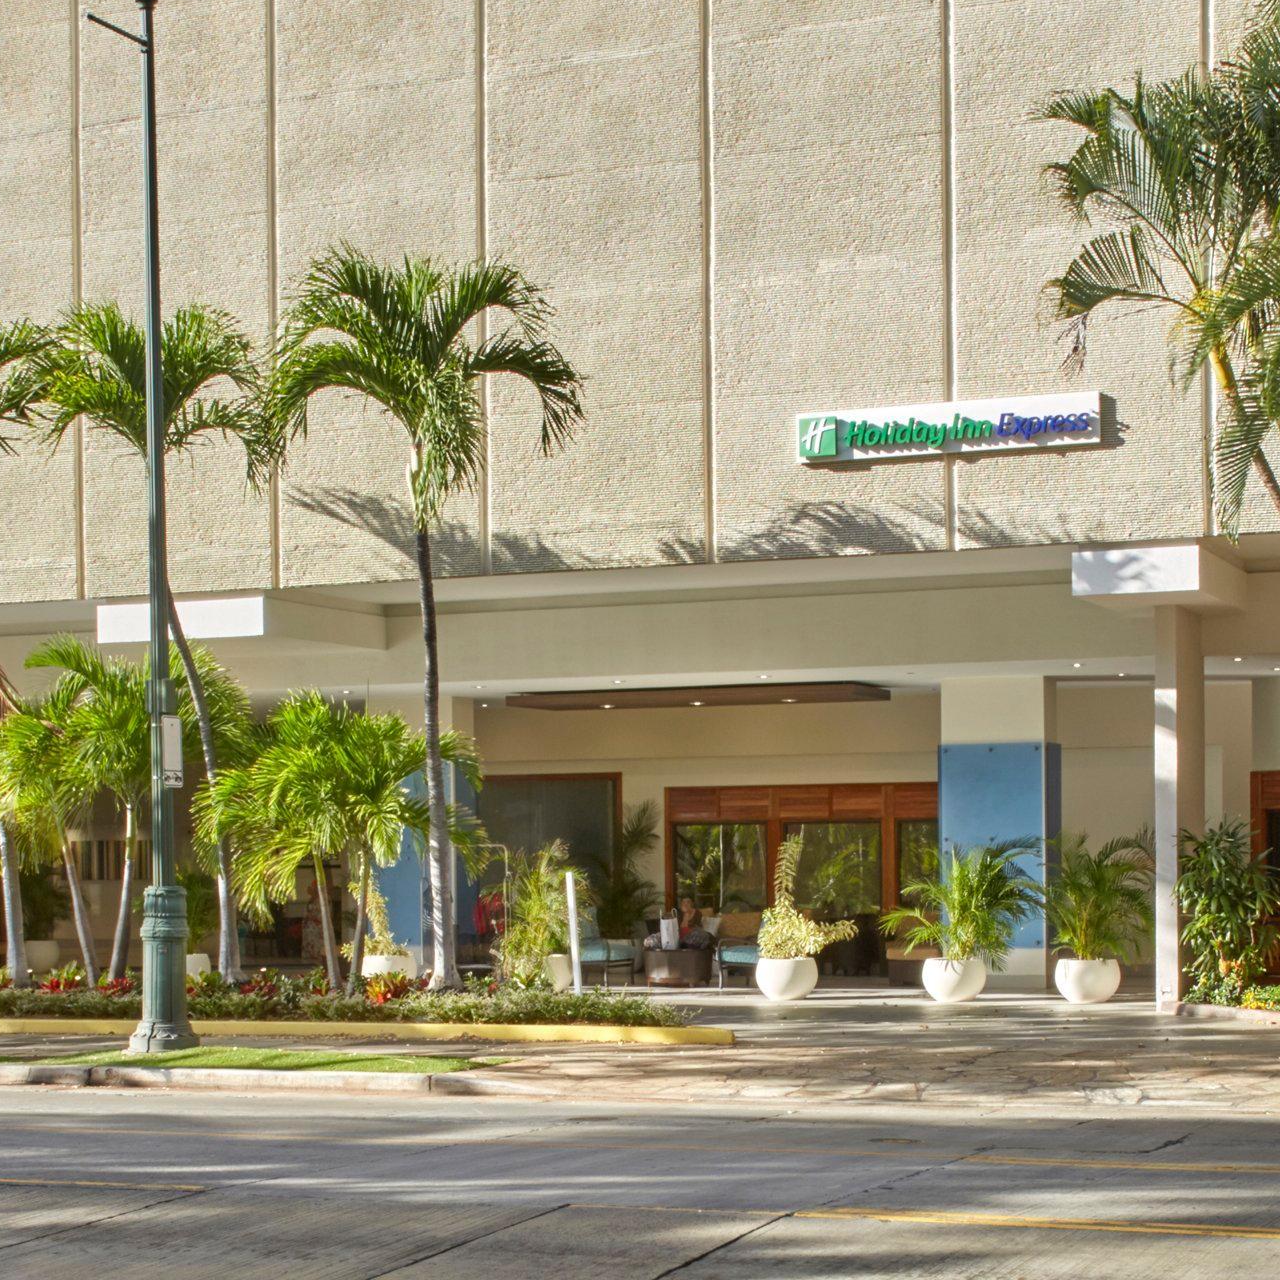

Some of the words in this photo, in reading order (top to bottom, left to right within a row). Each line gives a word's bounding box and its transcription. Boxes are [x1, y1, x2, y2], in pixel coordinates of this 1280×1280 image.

[844, 417, 947, 448] Holiday
[949, 413, 993, 440] Inn
[996, 412, 1091, 441] Express
